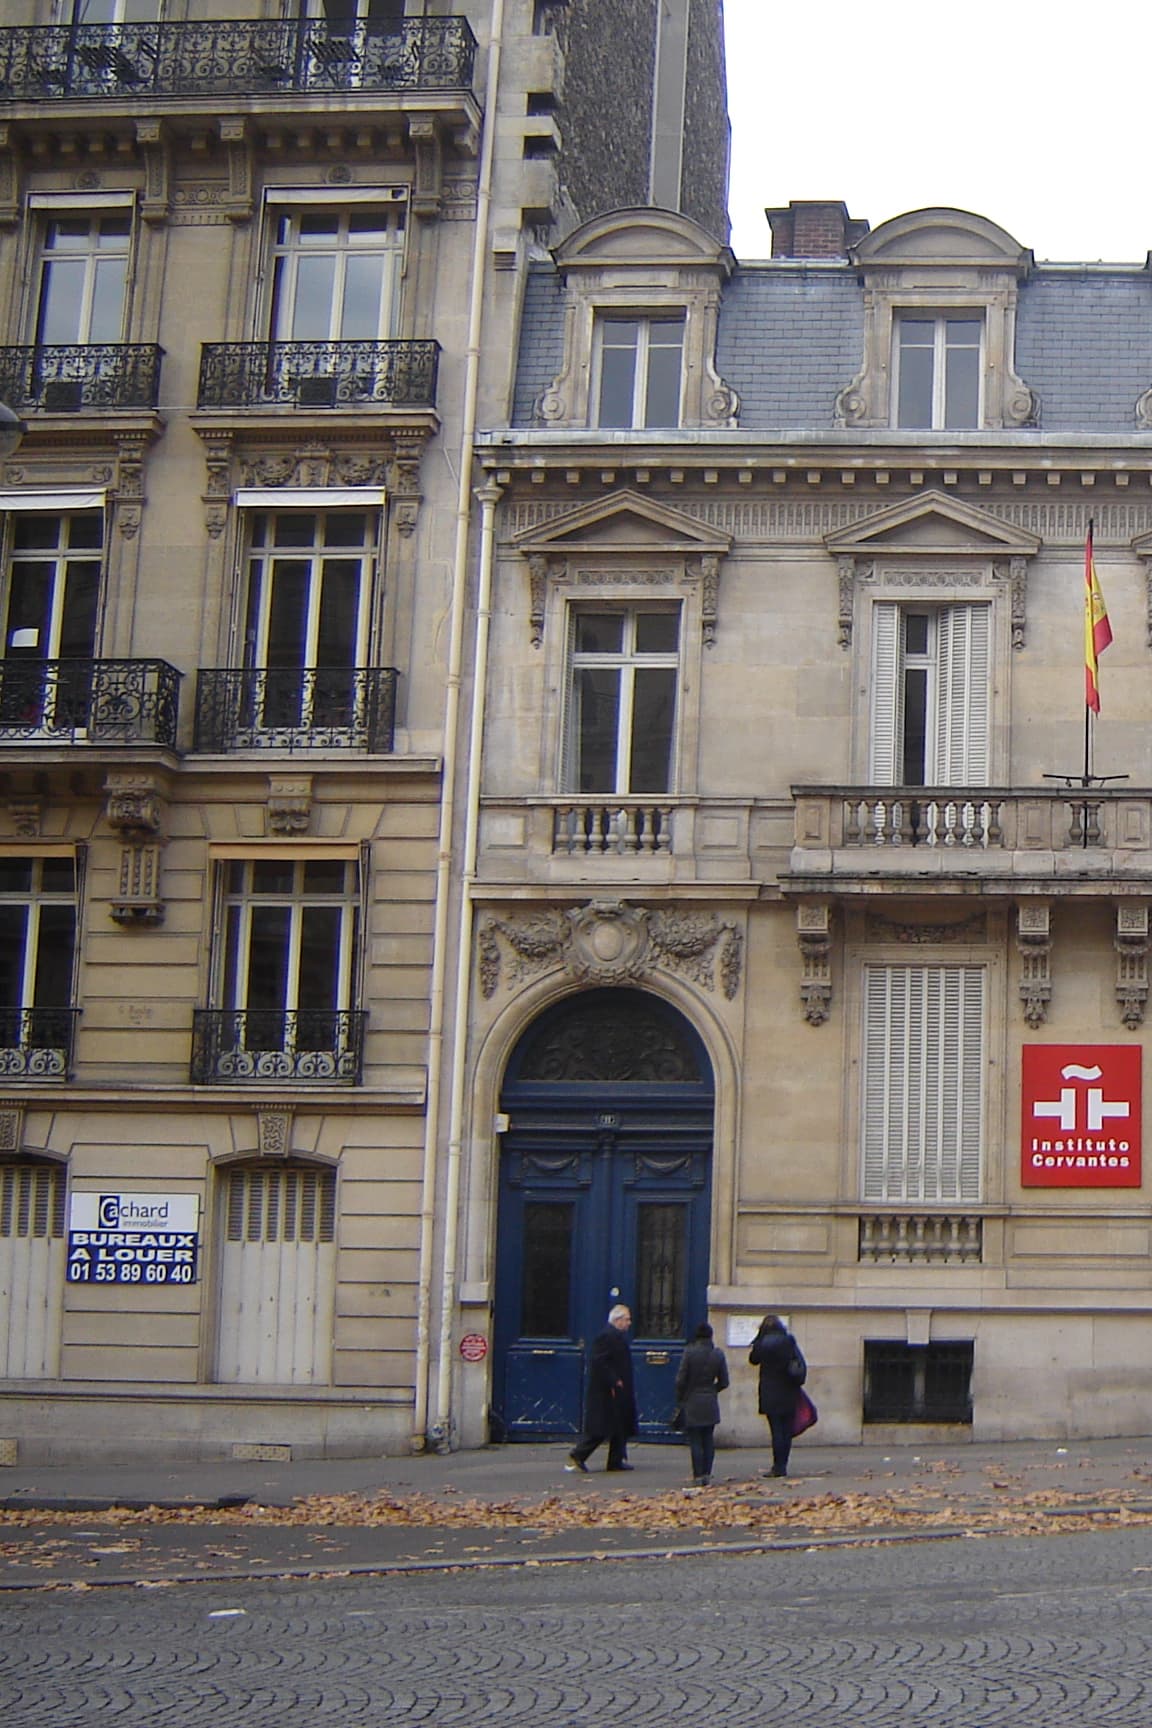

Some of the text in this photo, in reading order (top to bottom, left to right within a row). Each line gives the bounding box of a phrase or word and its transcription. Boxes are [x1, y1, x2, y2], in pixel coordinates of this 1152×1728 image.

[1032, 1138, 1129, 1152] Instituto
[1032, 1154, 1130, 1168] Cervantes
[99, 1196, 169, 1227] Cachard
[122, 1219, 168, 1229] immobilier
[72, 1233, 195, 1248] BUREAUX
[70, 1248, 194, 1263] A LOUER
[71, 1262, 192, 1283] 01 53 89 60 40
